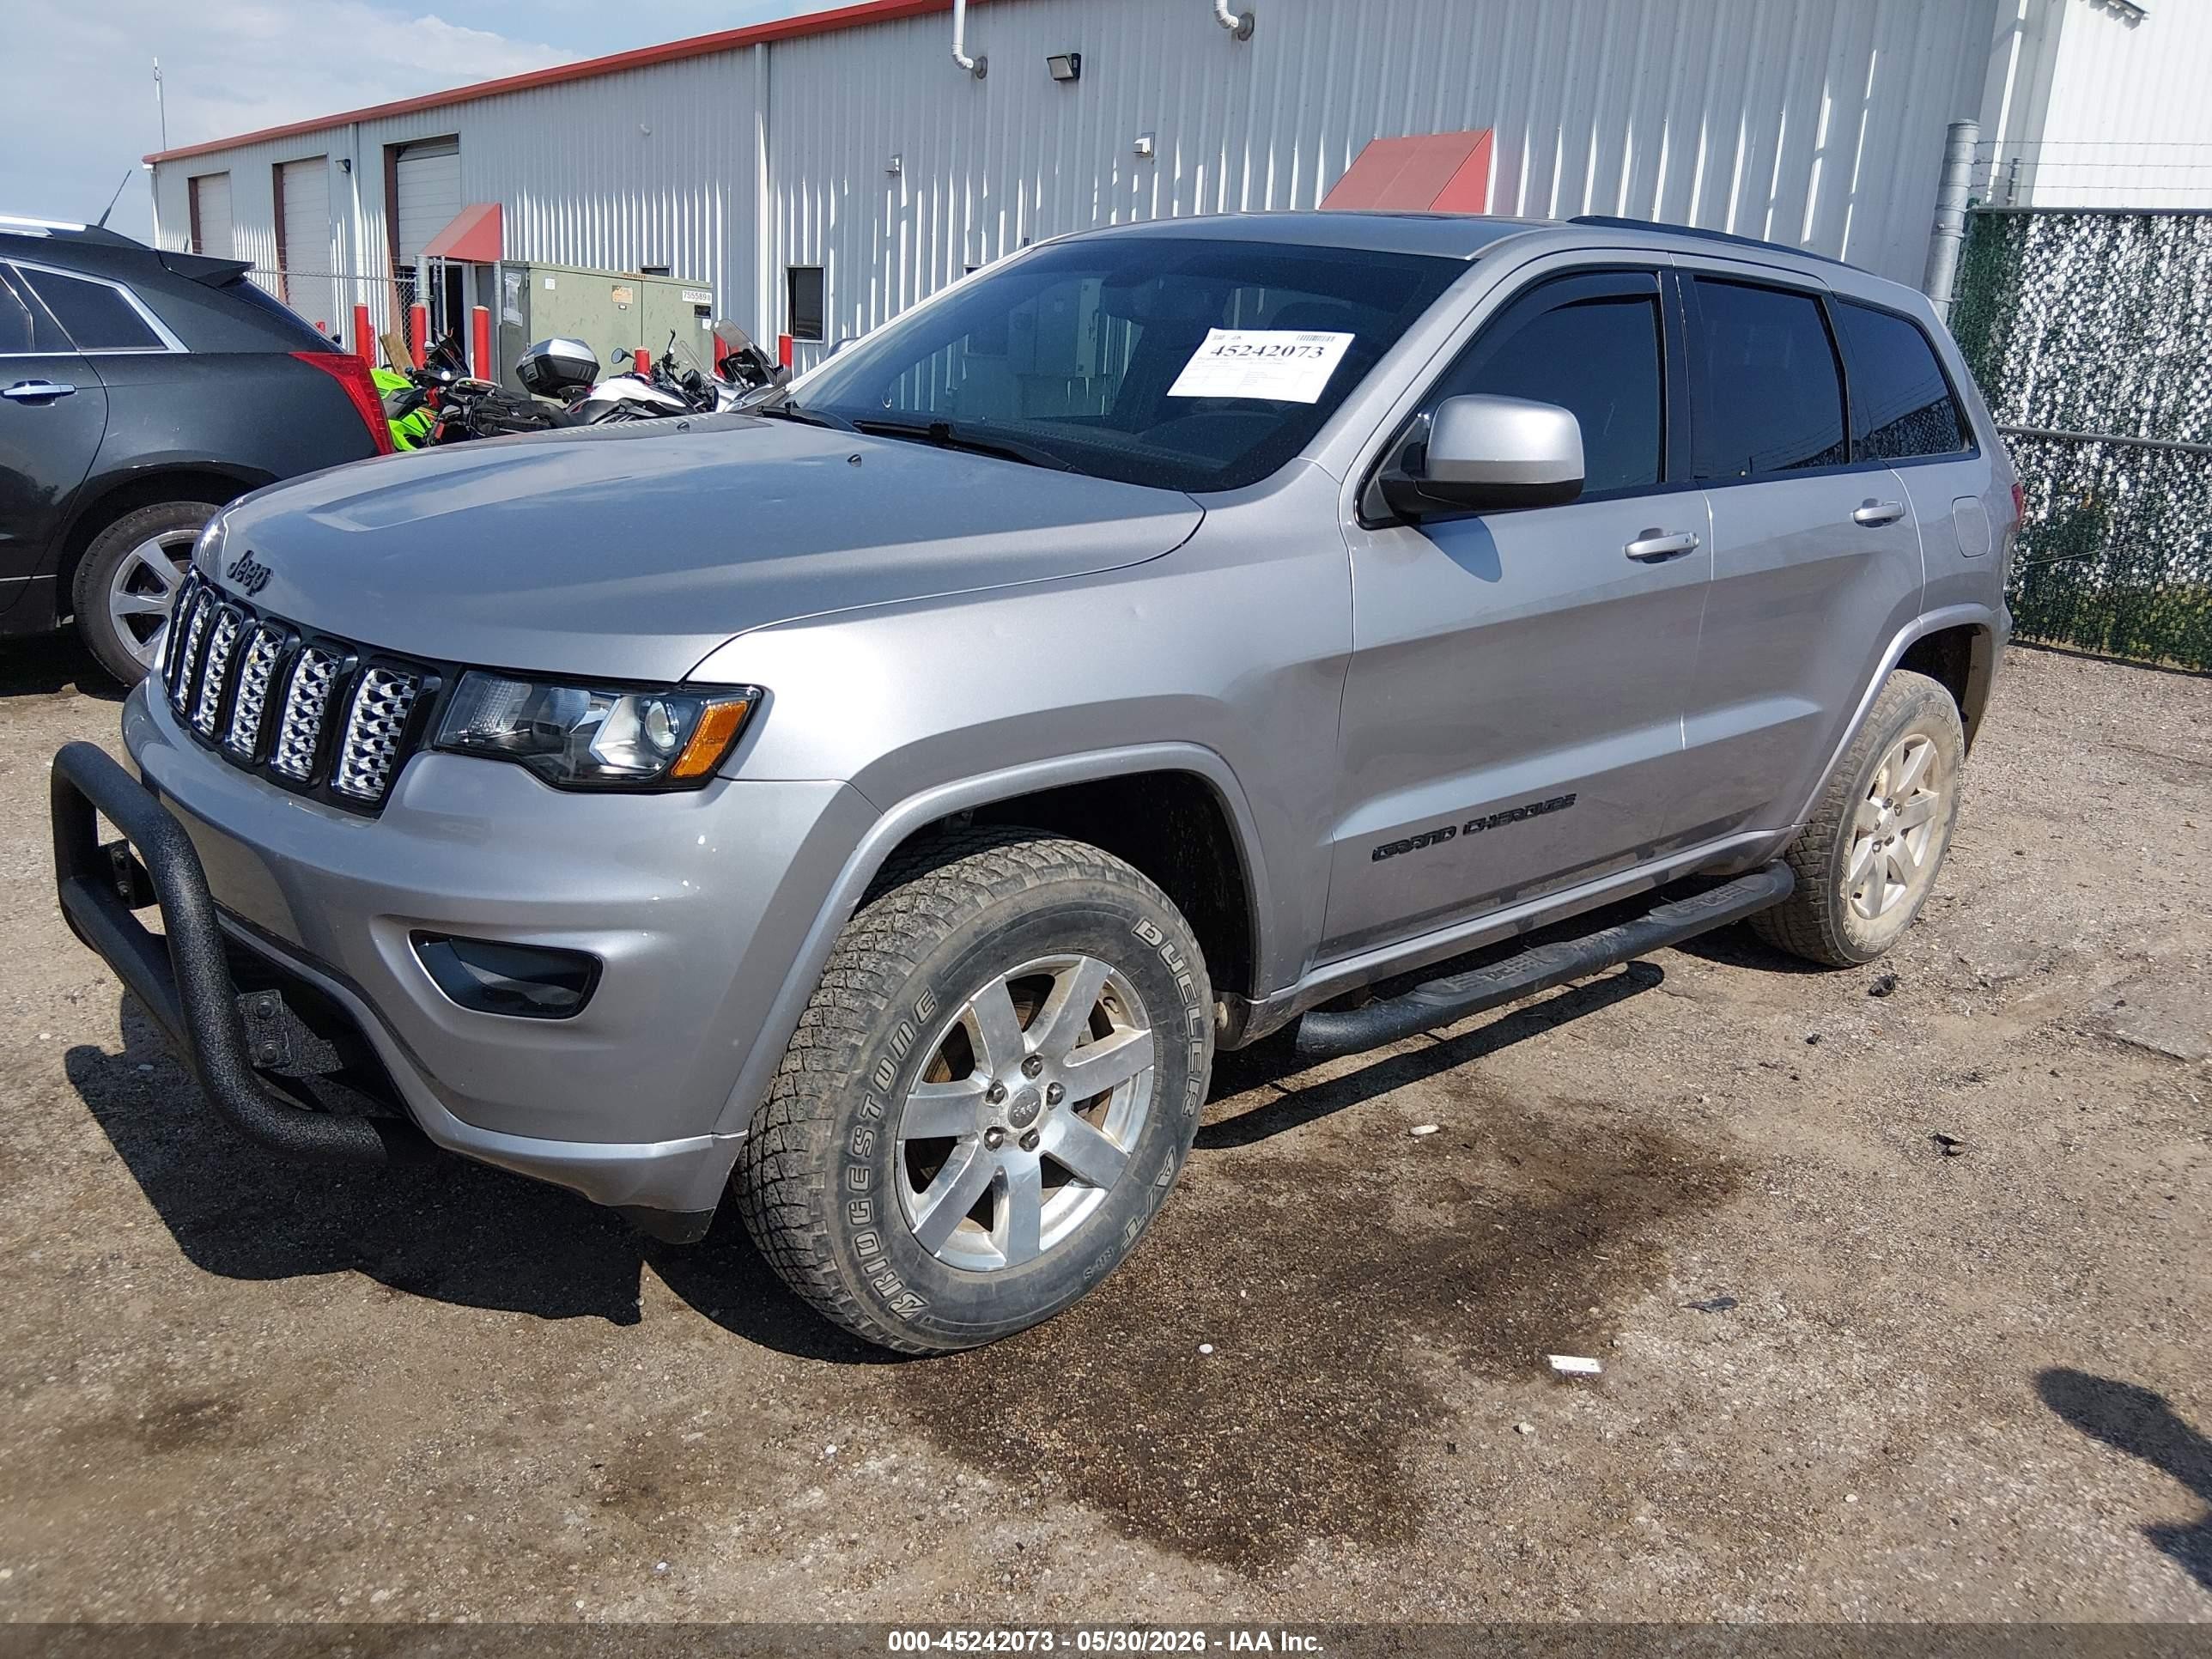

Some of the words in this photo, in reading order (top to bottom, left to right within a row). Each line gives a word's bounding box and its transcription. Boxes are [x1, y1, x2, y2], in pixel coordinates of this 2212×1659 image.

[1210, 344, 1325, 359] 45242073
[226, 550, 273, 598] Jeep
[1371, 825, 1456, 863] GRAND
[1462, 793, 1577, 836] CHEROKEE
[1132, 918, 1202, 1118] DUELER
[848, 987, 937, 1321] BRIDGESTONE
